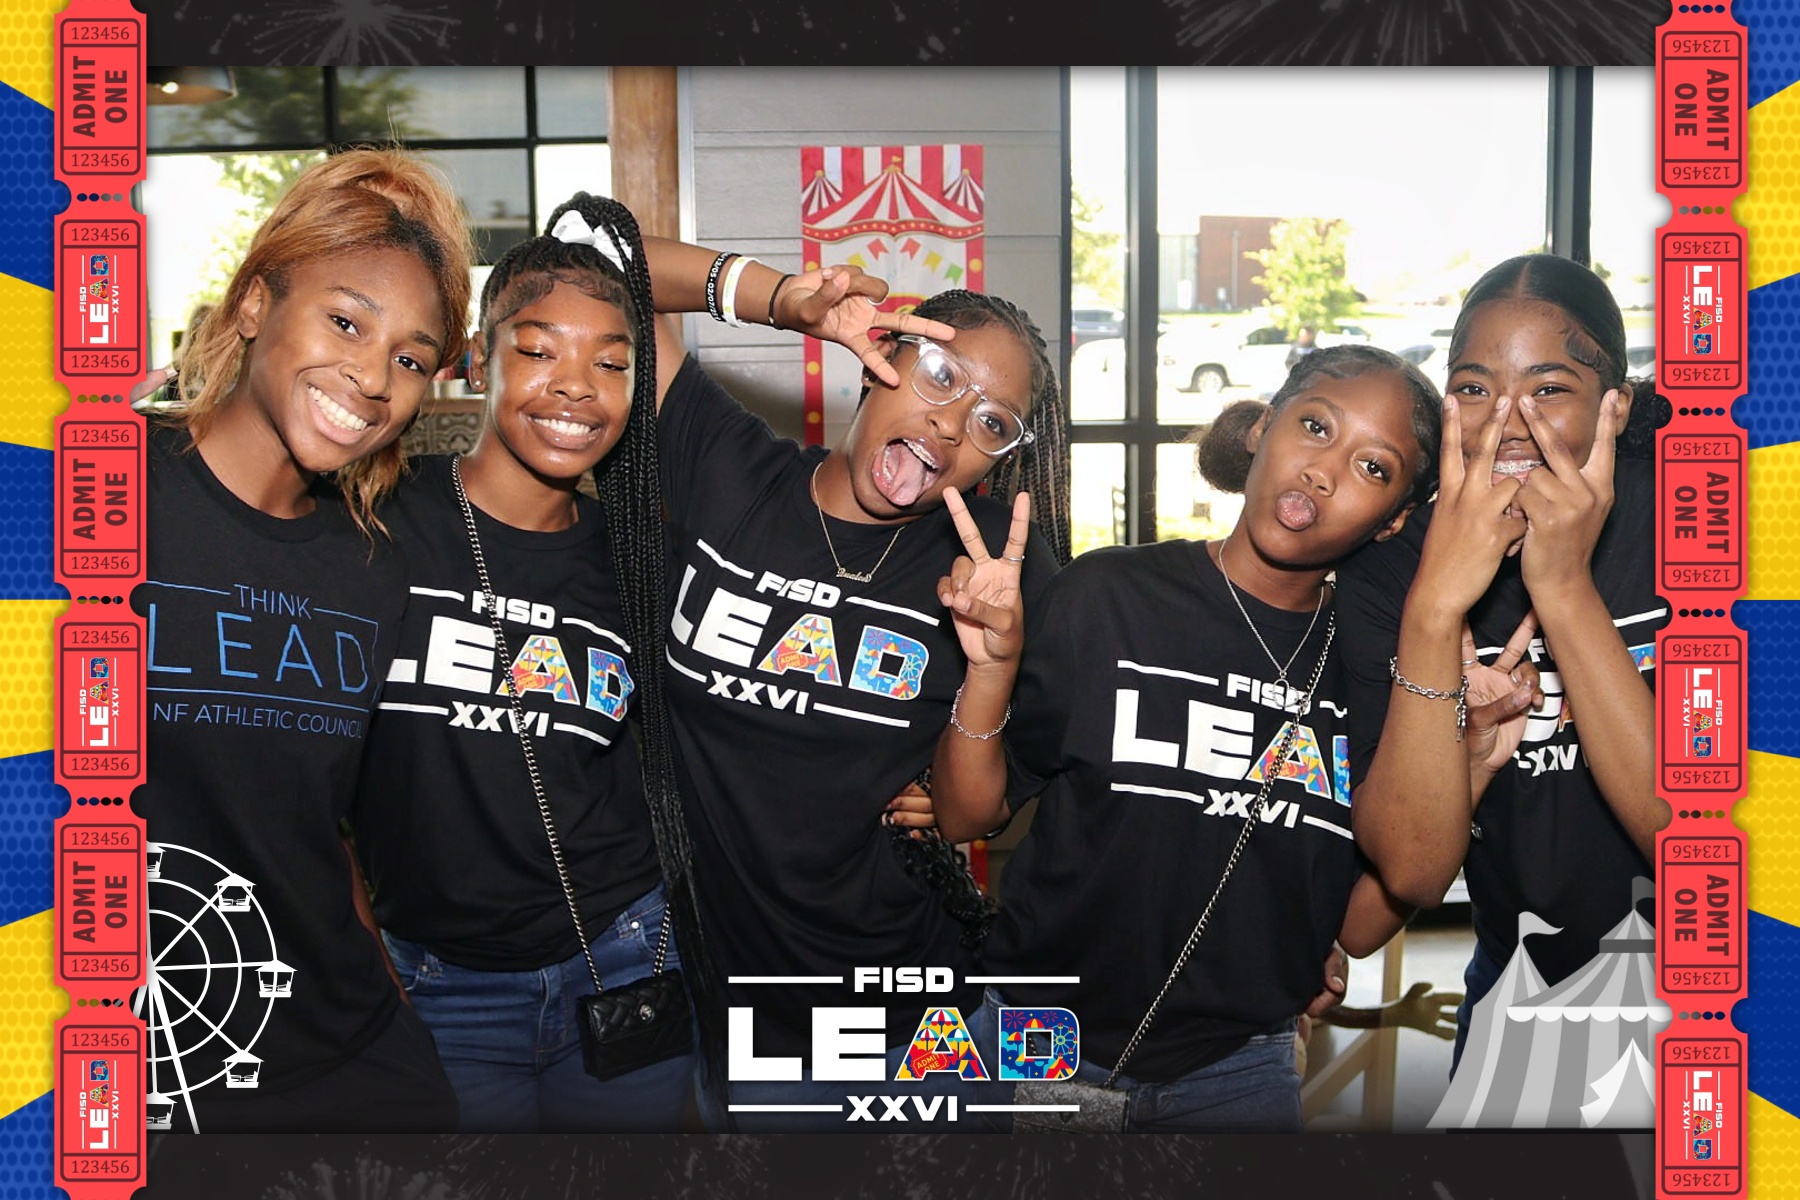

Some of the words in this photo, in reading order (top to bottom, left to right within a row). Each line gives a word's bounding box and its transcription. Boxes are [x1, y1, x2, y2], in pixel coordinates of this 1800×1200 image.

[233, 583, 312, 620] THINK
[755, 571, 841, 608] FISD
[147, 603, 369, 693] LEAD
[671, 564, 929, 701] LEAD
[707, 670, 809, 715] XXVI
[153, 703, 189, 722] NF
[194, 704, 293, 729] ATHLETIC
[297, 712, 364, 739] COUNCIL
[449, 701, 550, 738] XXVI
[1204, 788, 1300, 829] XXVI
